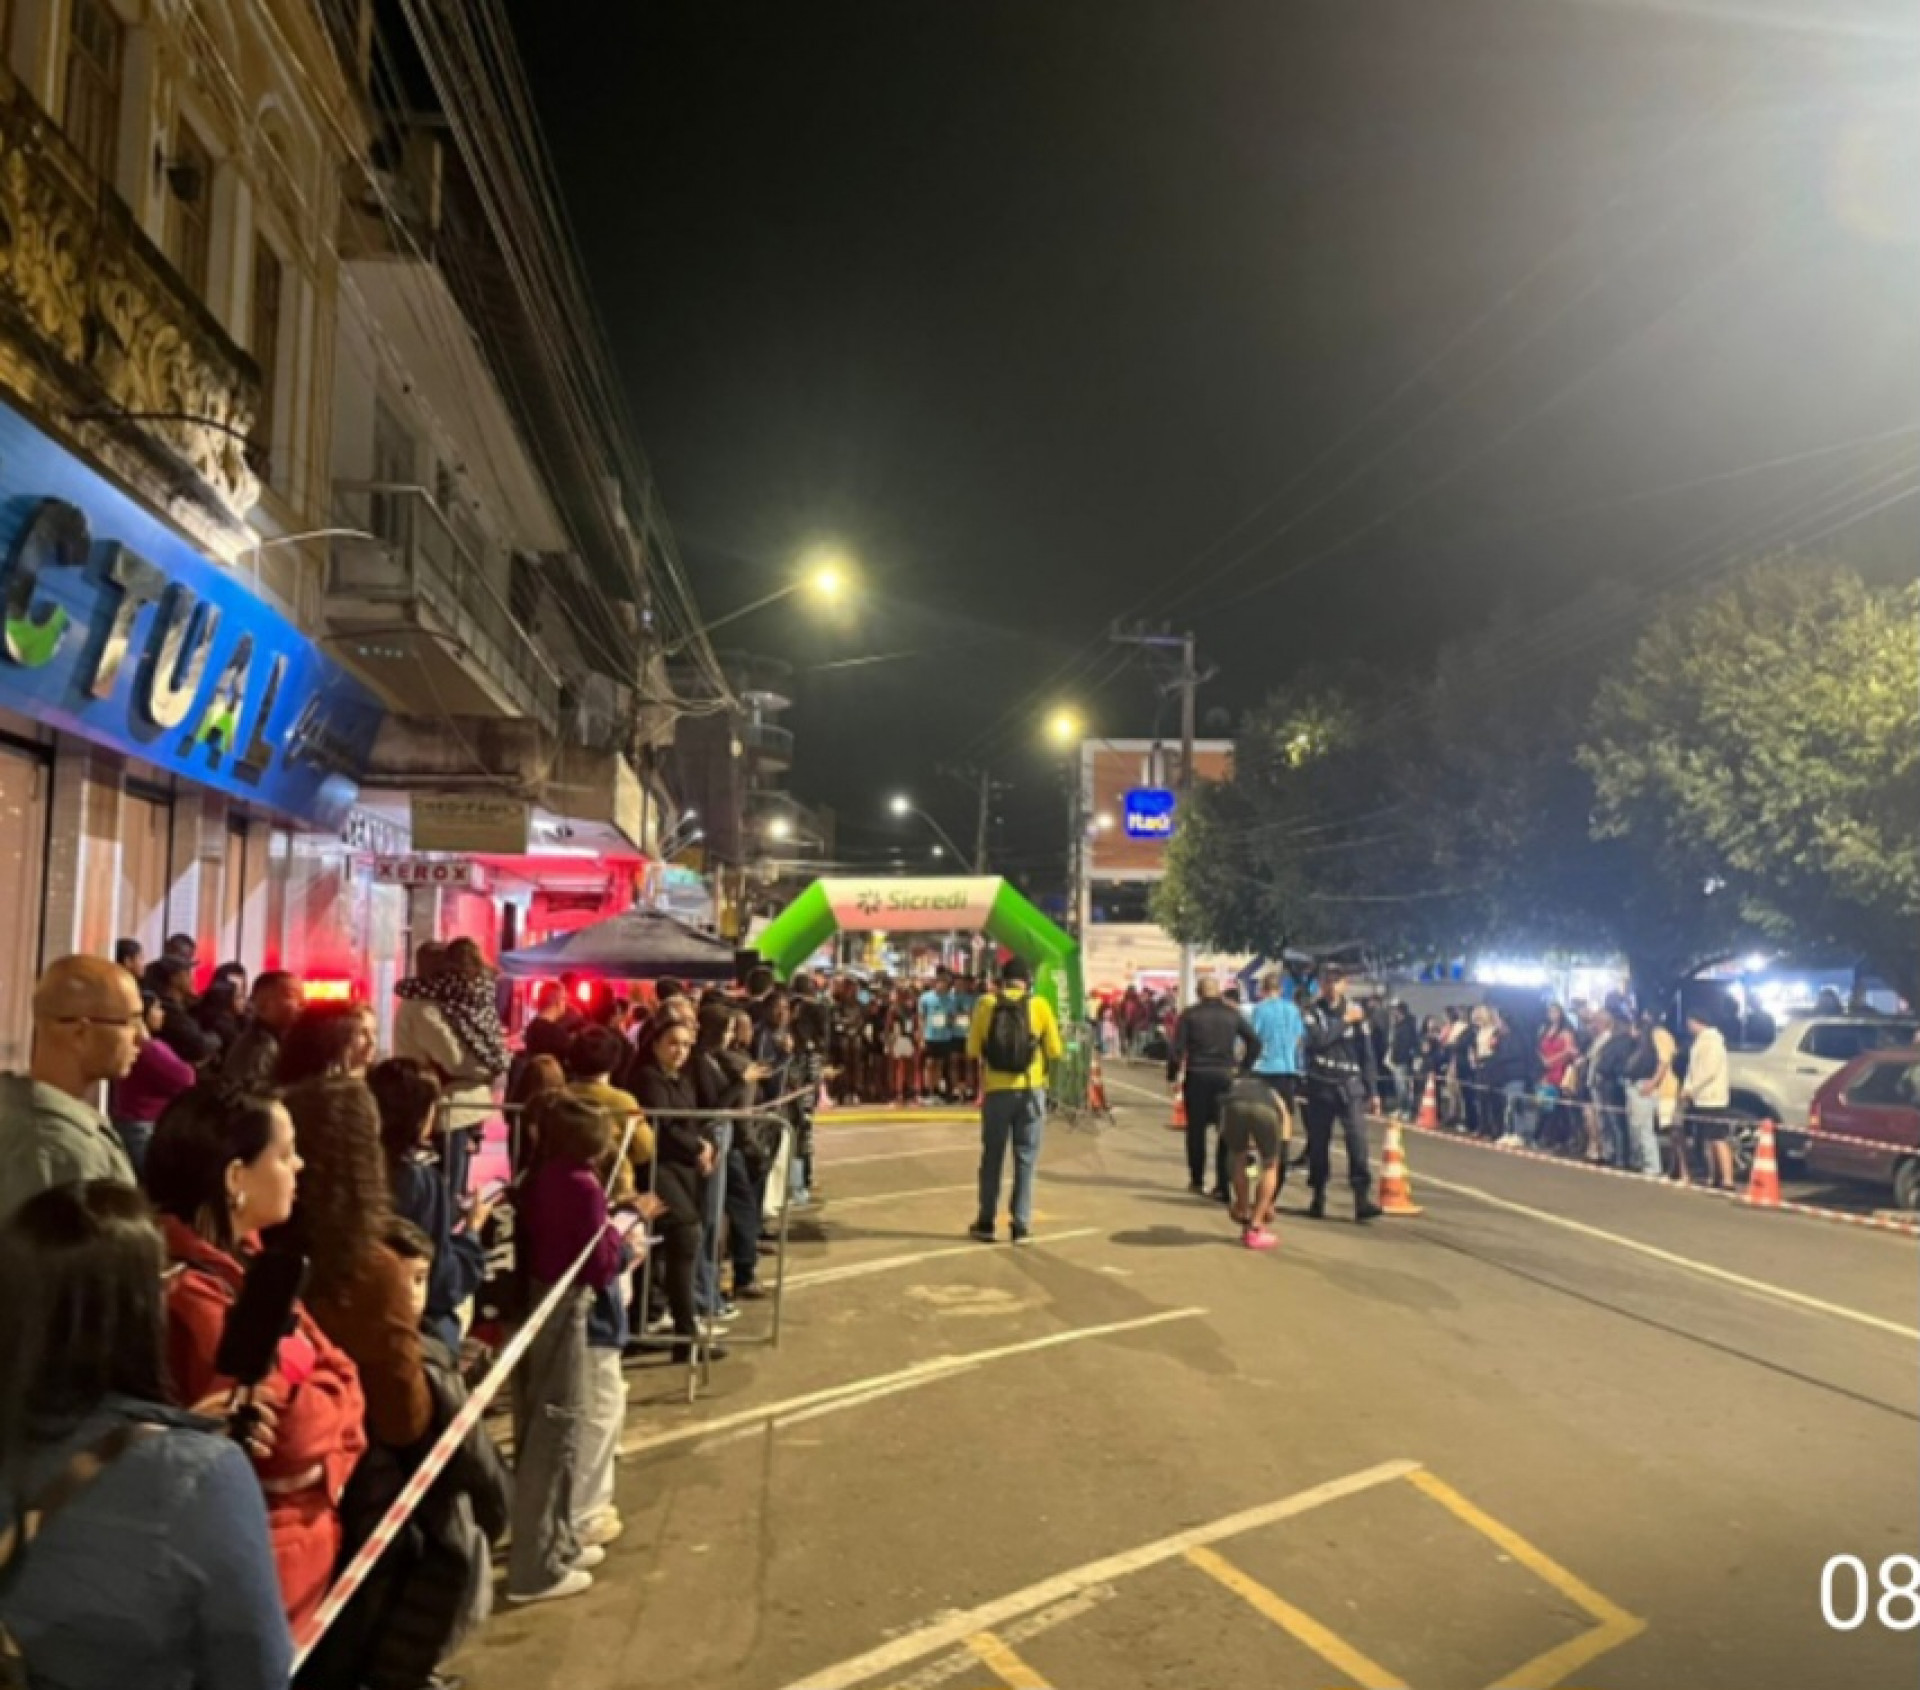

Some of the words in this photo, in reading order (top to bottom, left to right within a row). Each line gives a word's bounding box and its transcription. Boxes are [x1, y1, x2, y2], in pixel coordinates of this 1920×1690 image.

[3, 495, 290, 786] CTUAL
[379, 862, 467, 881] XEROX
[886, 889, 967, 911] Sicredi
